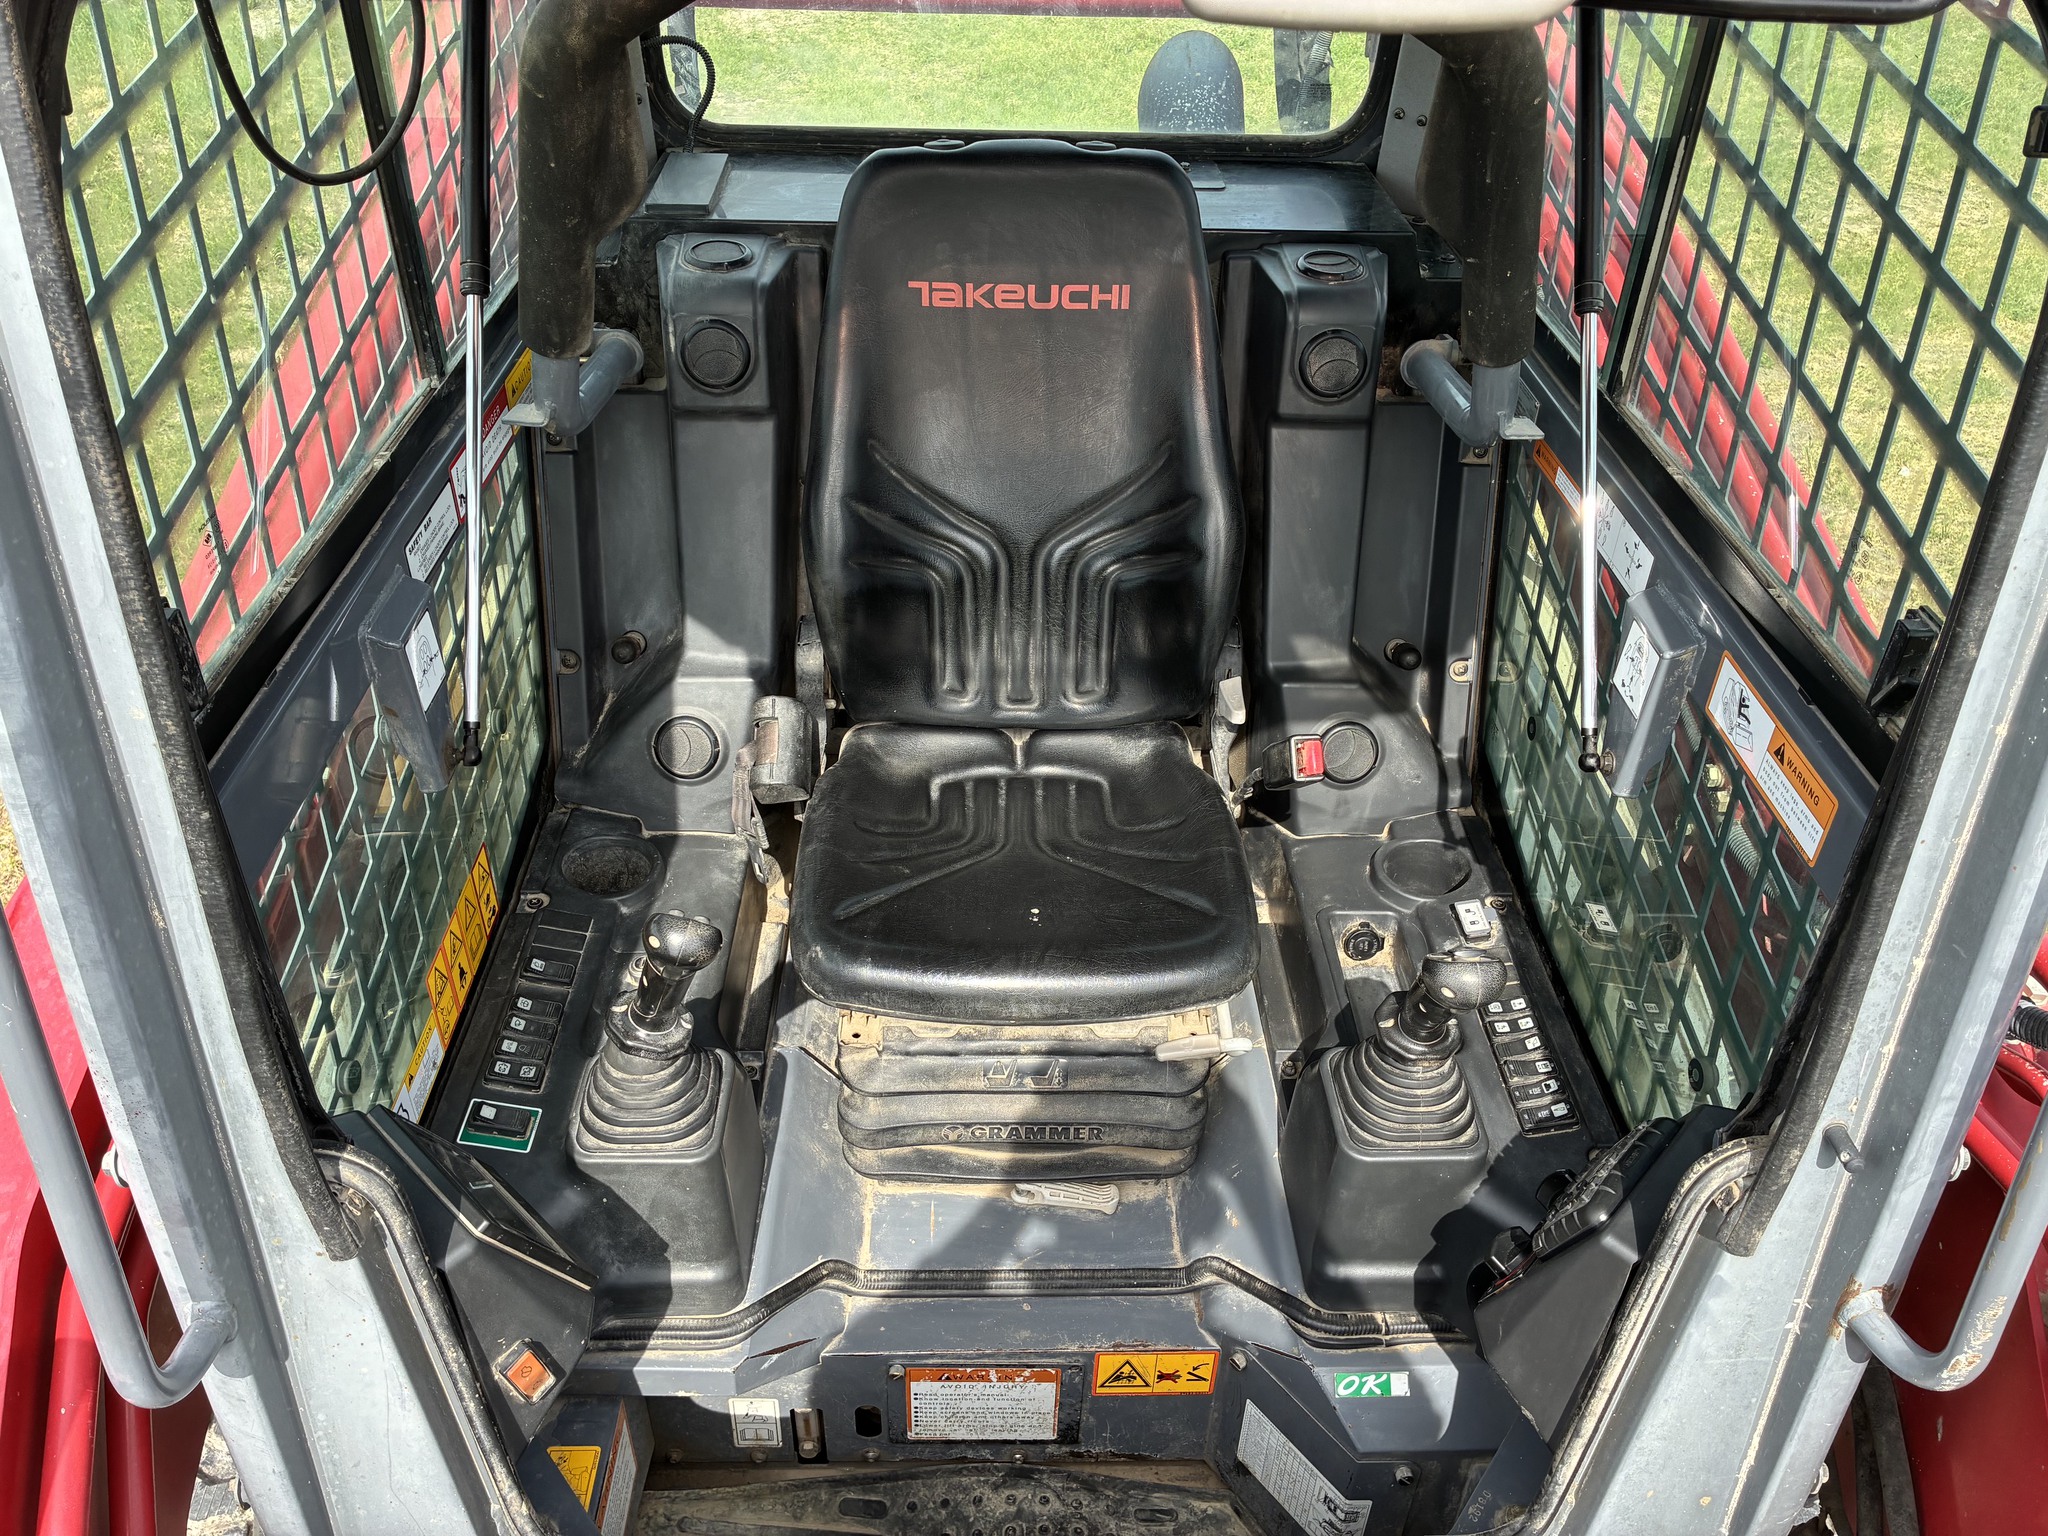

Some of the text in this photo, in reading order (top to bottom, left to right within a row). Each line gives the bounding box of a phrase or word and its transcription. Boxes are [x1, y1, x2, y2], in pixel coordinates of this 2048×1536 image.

[908, 280, 1130, 311] TAKEUCHI
[514, 359, 532, 387] CAUTIO
[482, 439, 492, 458] VOID
[408, 517, 432, 555] SAFETY BAR
[1766, 759, 1780, 779] ALWAYS
[1786, 757, 1820, 806] WARNING
[415, 1025, 431, 1065] CAUTION
[970, 1126, 1104, 1141] GRAMMER
[1337, 1373, 1388, 1397] OK
